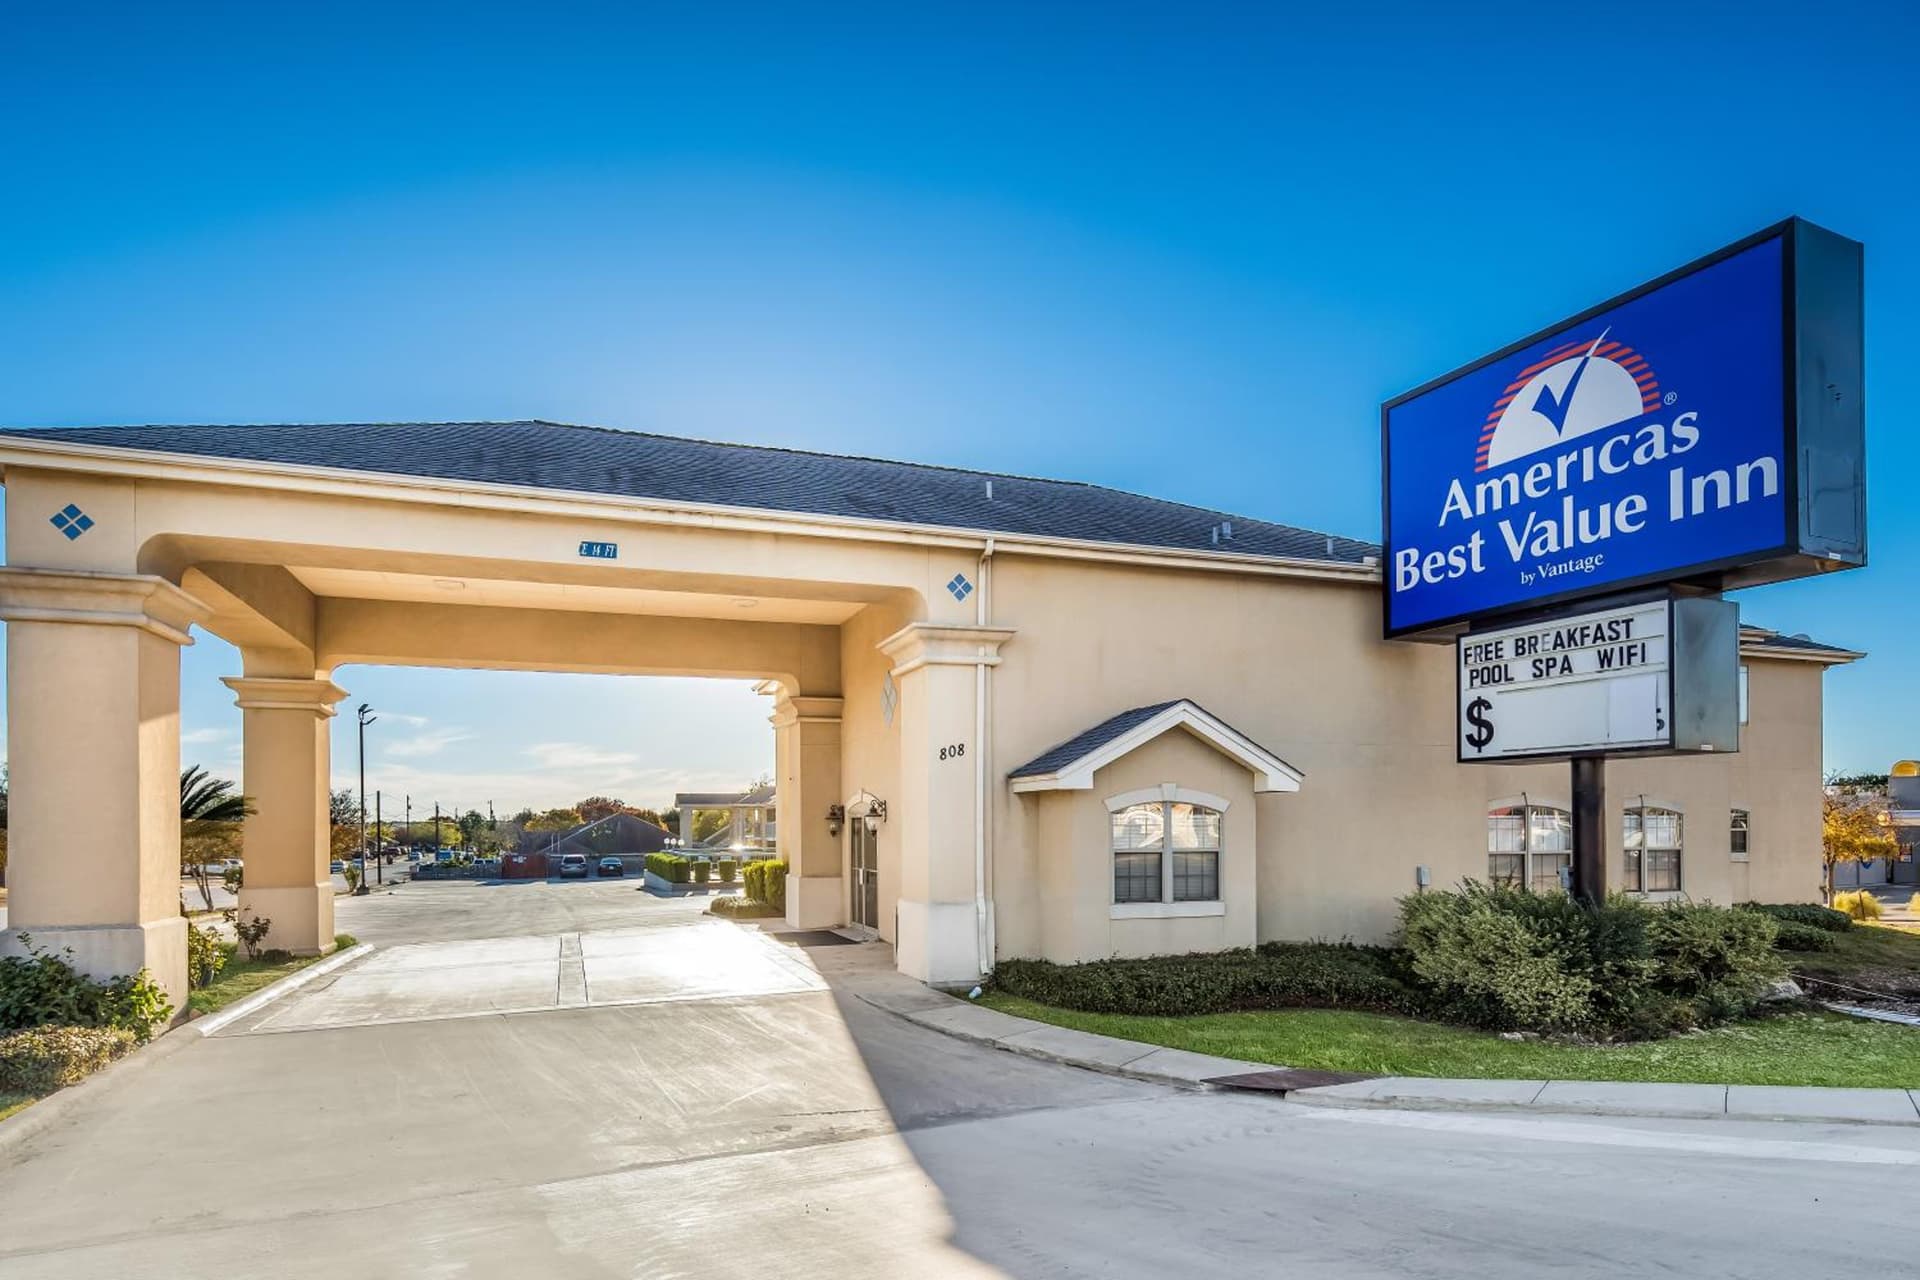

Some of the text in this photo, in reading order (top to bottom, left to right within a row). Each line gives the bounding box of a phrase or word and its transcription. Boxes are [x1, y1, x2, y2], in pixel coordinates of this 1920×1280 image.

[1438, 410, 1701, 527] Americas
[1395, 456, 1778, 593] Best Value Inn
[1520, 552, 1605, 586] by Vantage
[1464, 618, 1635, 665] FREE BREAKFAST
[1469, 642, 1647, 688] POOL SPA WIFI
[1464, 695, 1495, 753] $
[939, 743, 965, 761] 808
